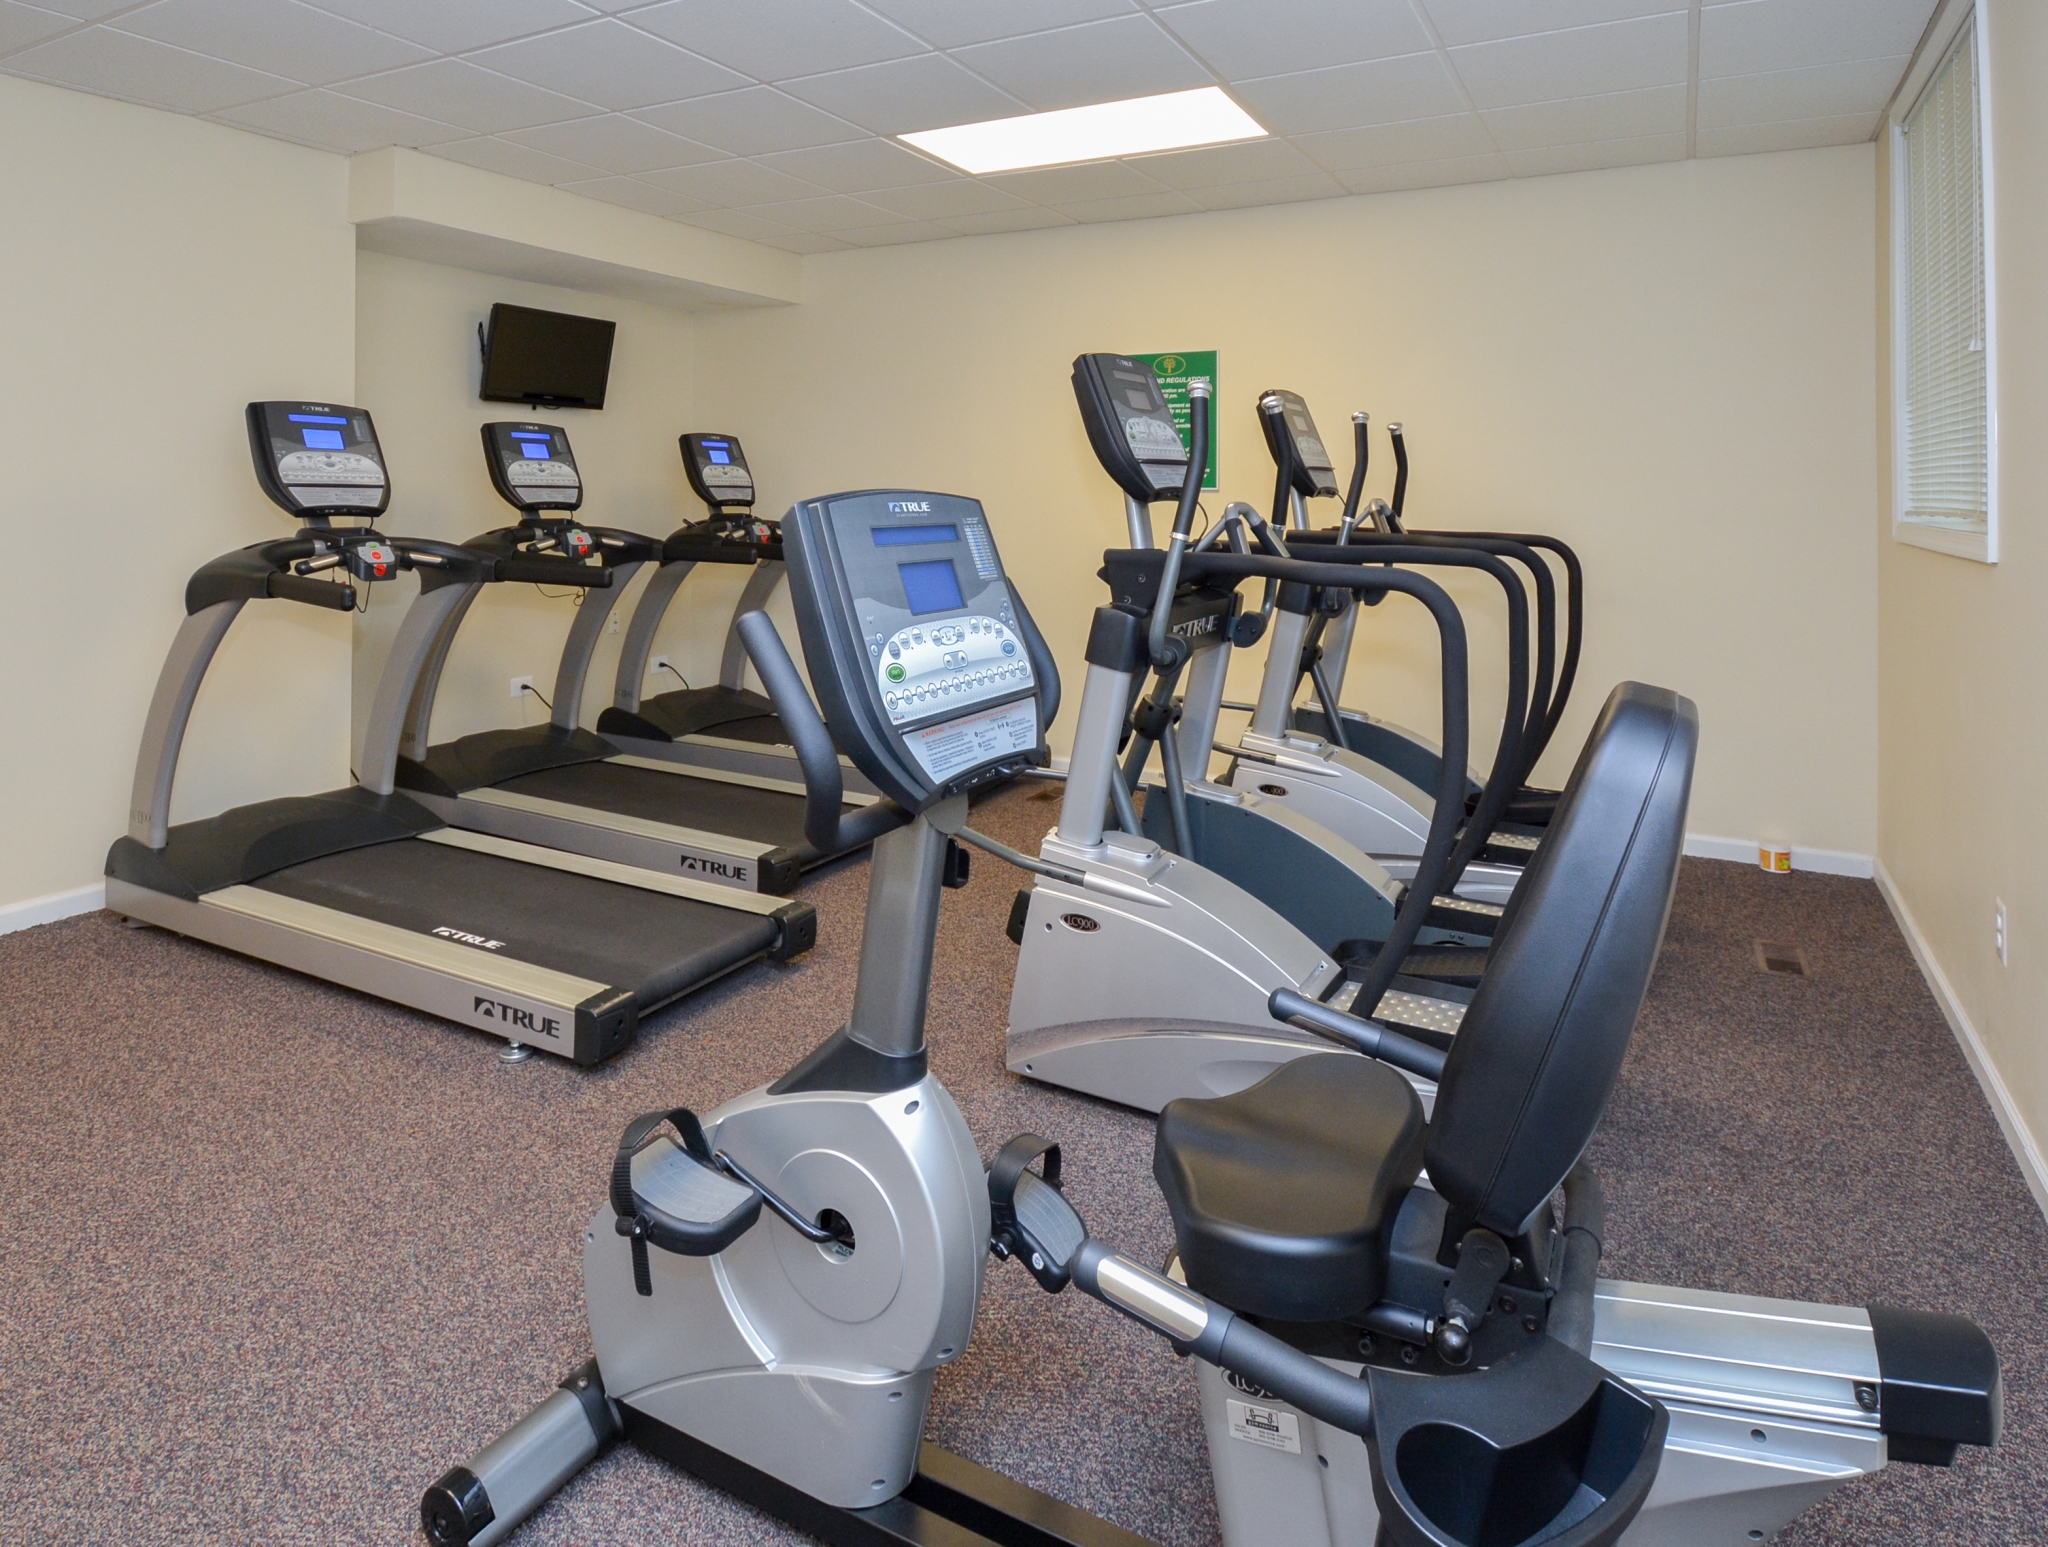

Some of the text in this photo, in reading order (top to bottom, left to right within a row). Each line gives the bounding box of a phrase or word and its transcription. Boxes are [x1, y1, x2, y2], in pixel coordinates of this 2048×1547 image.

[1166, 375, 1210, 384] REGULATIONS
[899, 501, 931, 513] TRUE
[1186, 614, 1220, 637] TRUE
[698, 858, 747, 882] TRUE
[1067, 915, 1095, 930] LC900
[452, 931, 507, 950] TRUE
[496, 1002, 561, 1039] TRUE
